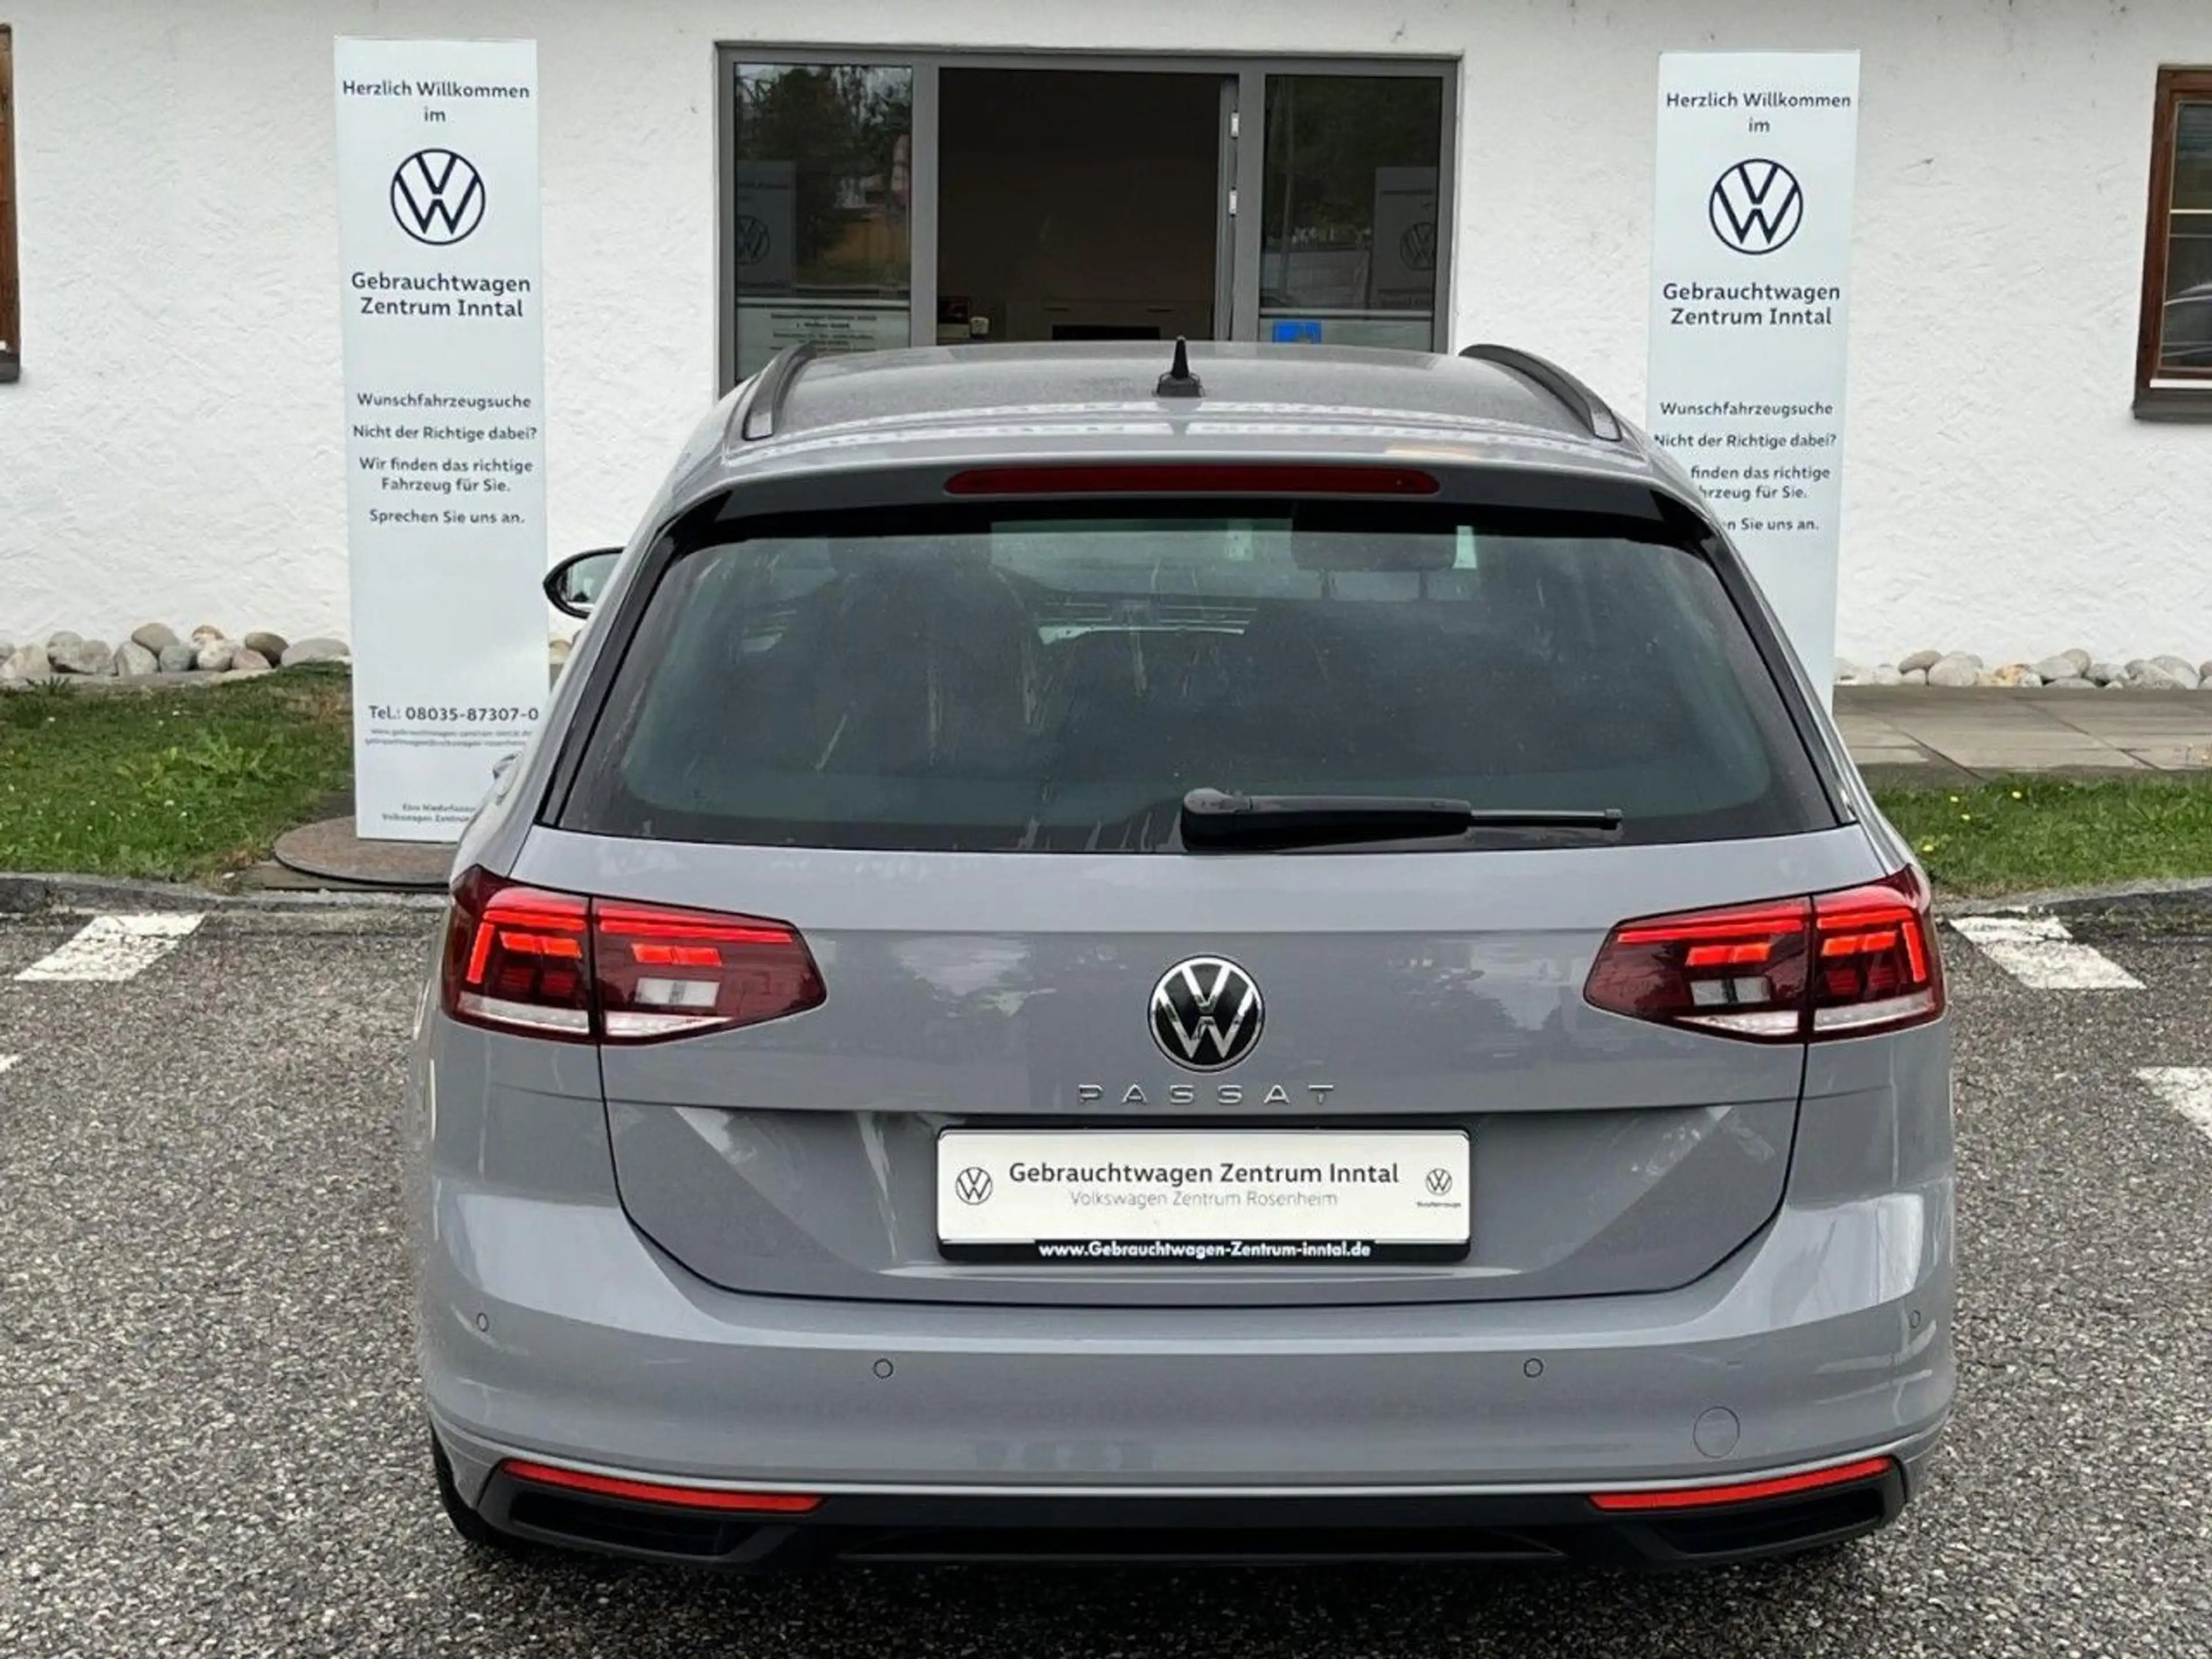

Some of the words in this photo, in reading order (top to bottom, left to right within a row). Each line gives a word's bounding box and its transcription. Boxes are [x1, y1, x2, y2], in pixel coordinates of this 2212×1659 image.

[343, 81, 412, 96] Herzlich
[416, 82, 529, 98] Willkommen
[1666, 93, 1737, 108] Herzlich
[1744, 93, 1851, 108] Willkommen
[424, 107, 445, 122] im
[1749, 118, 1770, 132] im
[391, 149, 485, 246] VW
[1709, 158, 1803, 255] VW
[351, 271, 531, 296] Gebrauchtwagen
[1663, 283, 1840, 304] Gebrauchtwagen
[361, 297, 450, 316] Zentrum
[458, 299, 523, 317] Inntal
[1671, 308, 1762, 324] Zentrum
[1770, 307, 1832, 324] Inntal
[357, 393, 531, 411] Wunschfahrzeugsuche
[1660, 402, 1833, 418] Wunschfahrzeugsuche
[353, 425, 391, 438] Nicht
[396, 425, 418, 438] der
[423, 426, 484, 442] Richtige
[489, 427, 537, 440] dabei?
[1698, 434, 1723, 446] der
[1726, 434, 1786, 449] Richtige
[1790, 434, 1836, 447] dabei?
[359, 457, 385, 469] Wir
[391, 457, 437, 471] finden
[442, 458, 468, 471] das
[474, 459, 533, 474] richtige
[1691, 465, 1739, 479] finden
[1743, 467, 1769, 479] das
[1773, 466, 1830, 482] richtige
[382, 477, 451, 494] Fahrzeug
[456, 478, 479, 491] für
[483, 479, 510, 492] Sie.
[1755, 486, 1778, 498] für
[1782, 485, 1807, 499] Sie.
[369, 509, 438, 524] Sprechen
[444, 510, 465, 523] Sie
[470, 512, 497, 524] uns
[501, 513, 525, 524] an.
[1741, 517, 1763, 530] Sie
[1767, 520, 1793, 531] uns
[1797, 520, 1819, 531] an.
[406, 707, 539, 721] 08035-87307-0
[1147, 954, 1265, 1073] VW
[1078, 1084, 1334, 1104] PASSAT
[1009, 1162, 1212, 1187] Gebrauchtwagen
[1221, 1163, 1321, 1182] Zentrum
[1331, 1162, 1399, 1183] Inntal
[955, 1166, 993, 1205] VW
[1071, 1191, 1167, 1210] Volkswagen
[1172, 1191, 1241, 1206] Zentrum
[1247, 1191, 1338, 1206] Rosenheim
